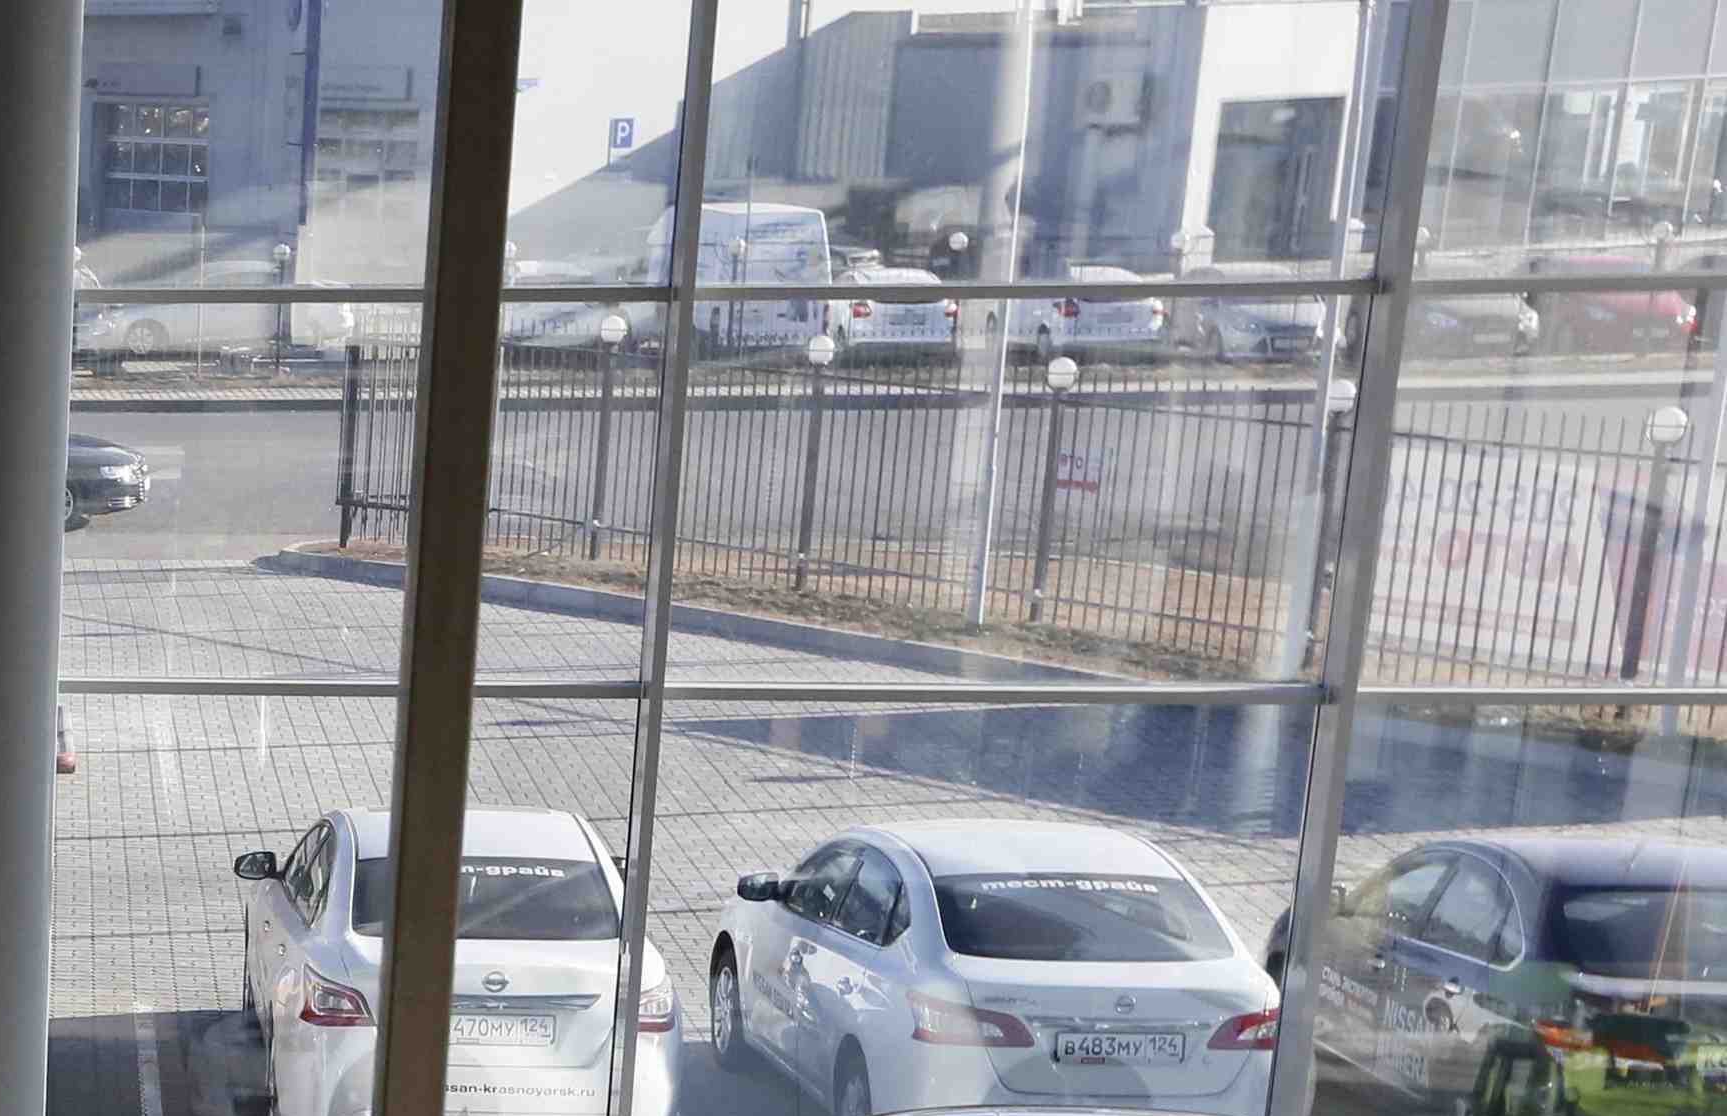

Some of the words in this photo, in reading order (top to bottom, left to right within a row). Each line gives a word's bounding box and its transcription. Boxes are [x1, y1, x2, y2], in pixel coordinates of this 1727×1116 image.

[616, 121, 630, 145] P
[461, 864, 566, 878] т-драйв
[449, 1017, 515, 1037] 470МУ
